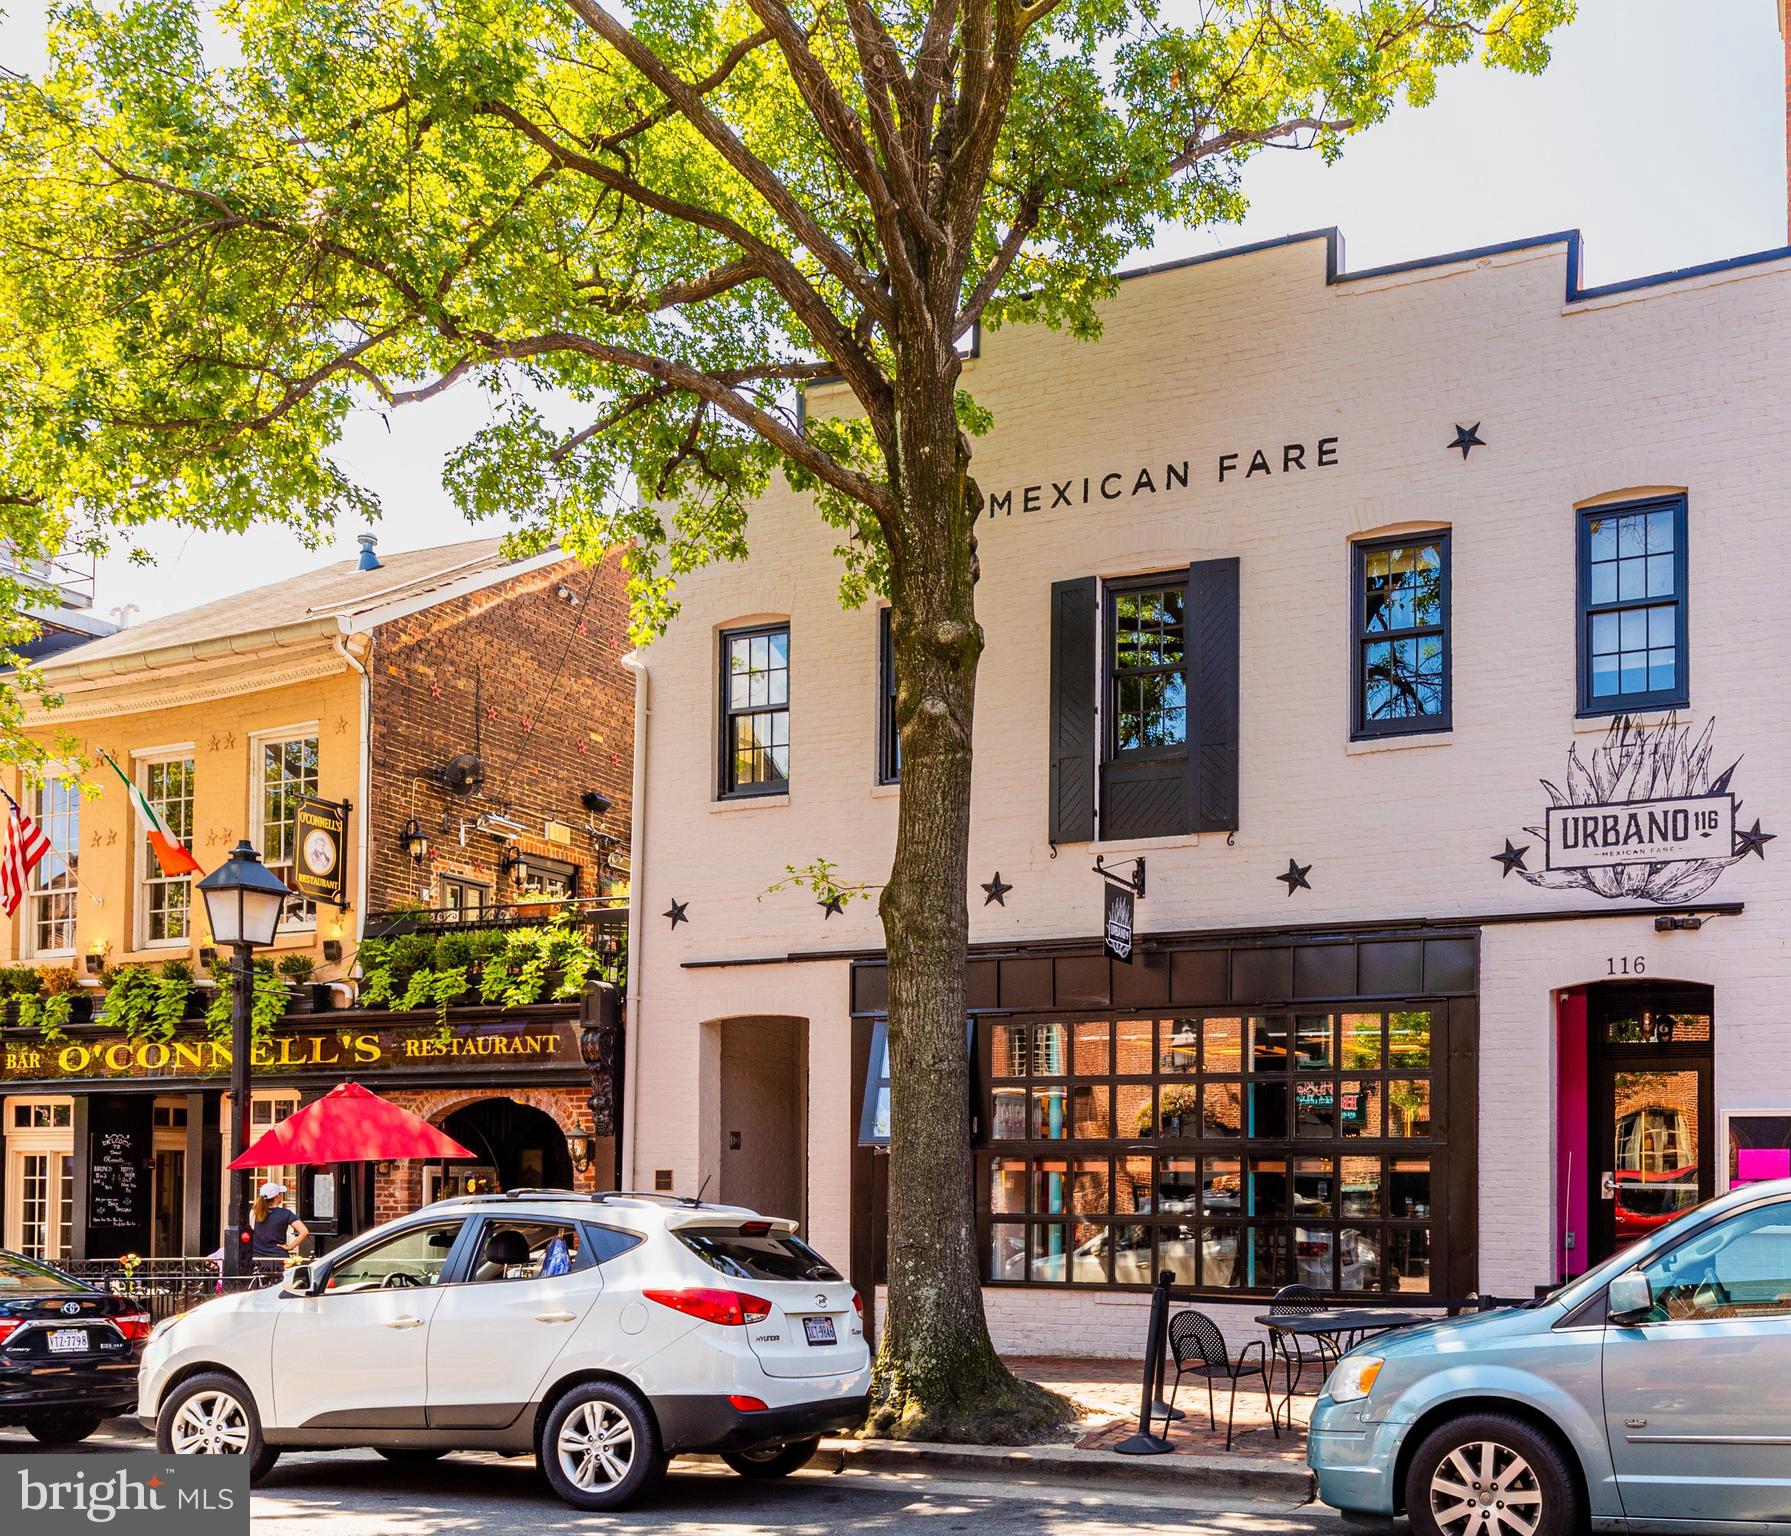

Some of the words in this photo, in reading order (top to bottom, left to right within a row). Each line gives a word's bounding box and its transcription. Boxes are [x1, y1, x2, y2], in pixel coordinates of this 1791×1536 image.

[989, 461, 1189, 518] MEXICAN
[1219, 437, 1339, 482] FARE
[300, 812, 342, 832] O'CONNELL'S
[1562, 809, 1689, 849] URBANO
[1694, 810, 1719, 830] 116
[1602, 849, 1645, 857] MEXICAN
[299, 873, 338, 890] RESTAURANT
[1607, 956, 1646, 975] 116
[7, 1053, 41, 1070] BAR
[58, 1034, 382, 1072] O'CONNELL'S
[405, 1035, 560, 1057] RESTAURANT
